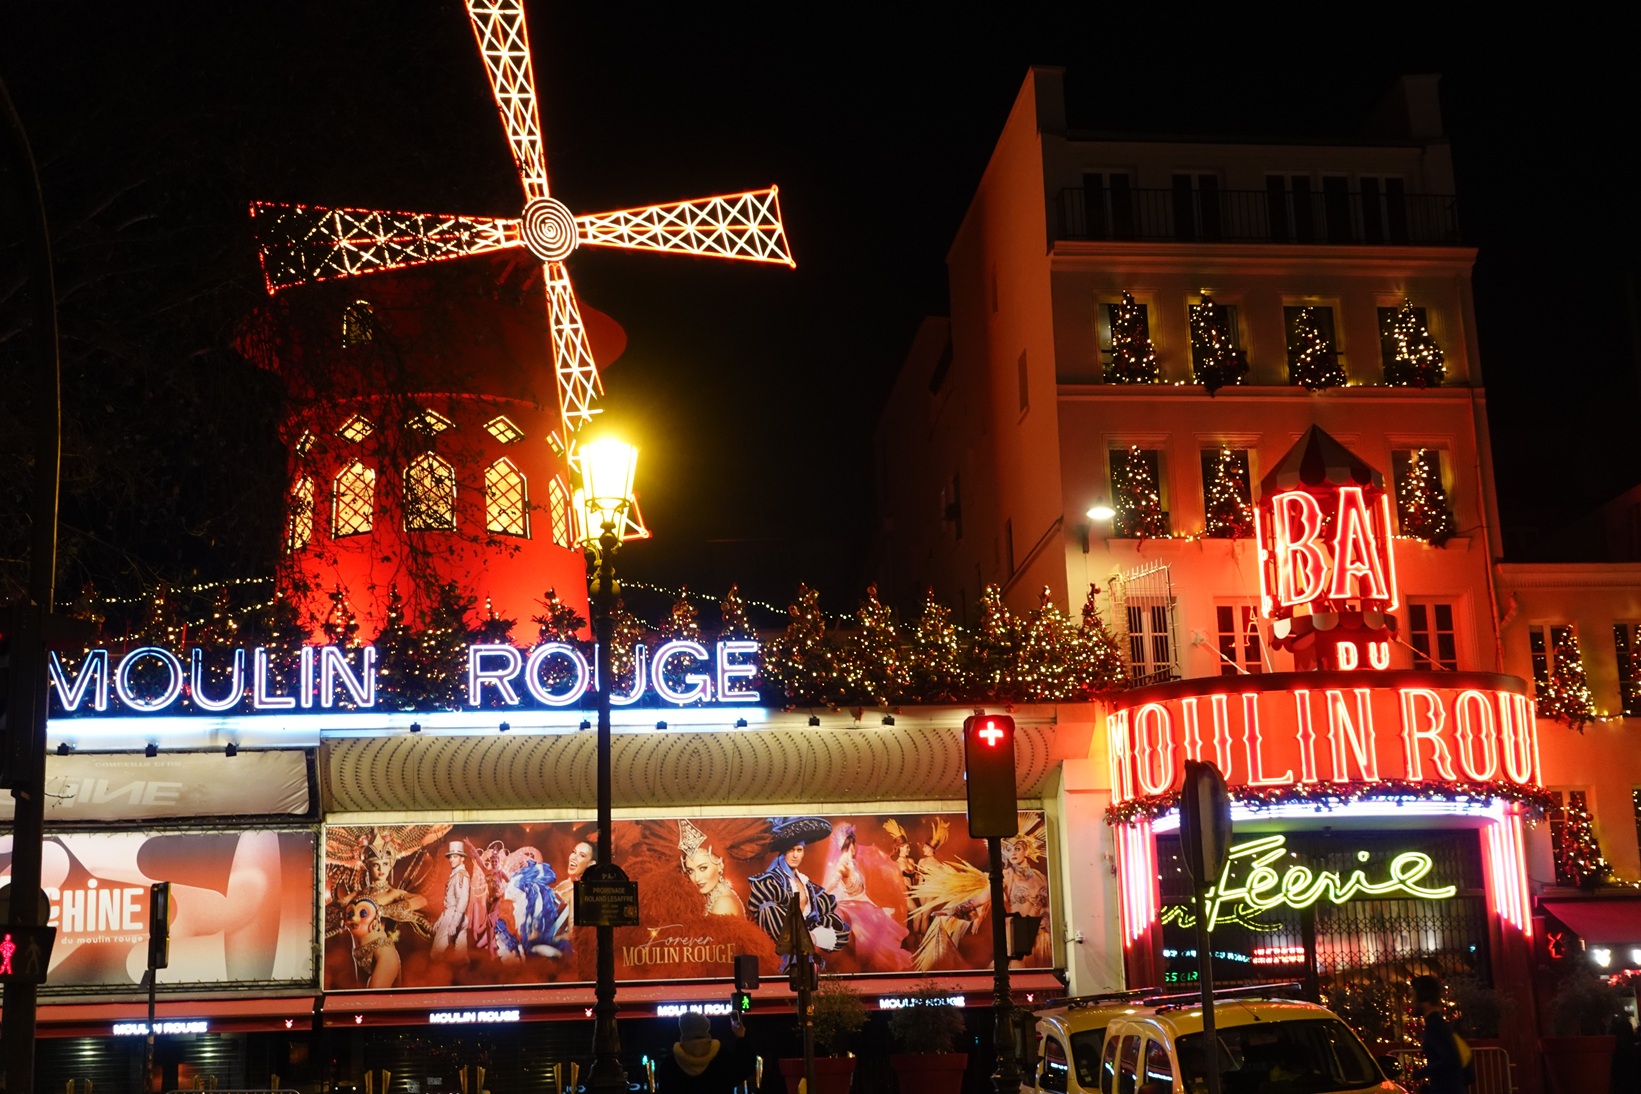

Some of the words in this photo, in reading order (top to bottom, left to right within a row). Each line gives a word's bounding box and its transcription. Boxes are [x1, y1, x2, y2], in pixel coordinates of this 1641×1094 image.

[1272, 486, 1399, 611] BA
[1337, 641, 1390, 670] DU
[48, 645, 376, 712] MOULIN
[469, 640, 761, 706] ROUGE
[1106, 688, 1380, 804] MOULIN
[1400, 688, 1542, 788] ROU
[44, 879, 144, 932] CHINE
[61, 936, 73, 945] du
[76, 935, 111, 944] moulin
[114, 935, 144, 944] rouge
[639, 923, 714, 947] Forever
[622, 945, 680, 967] MOULIN
[682, 943, 736, 964] ROUGE
[429, 1011, 476, 1024] MOULIN
[477, 1009, 520, 1023] ROUGE
[704, 1003, 733, 1016] ROU
[113, 1022, 163, 1036] MOULN
[163, 1021, 208, 1034] ROUGE
